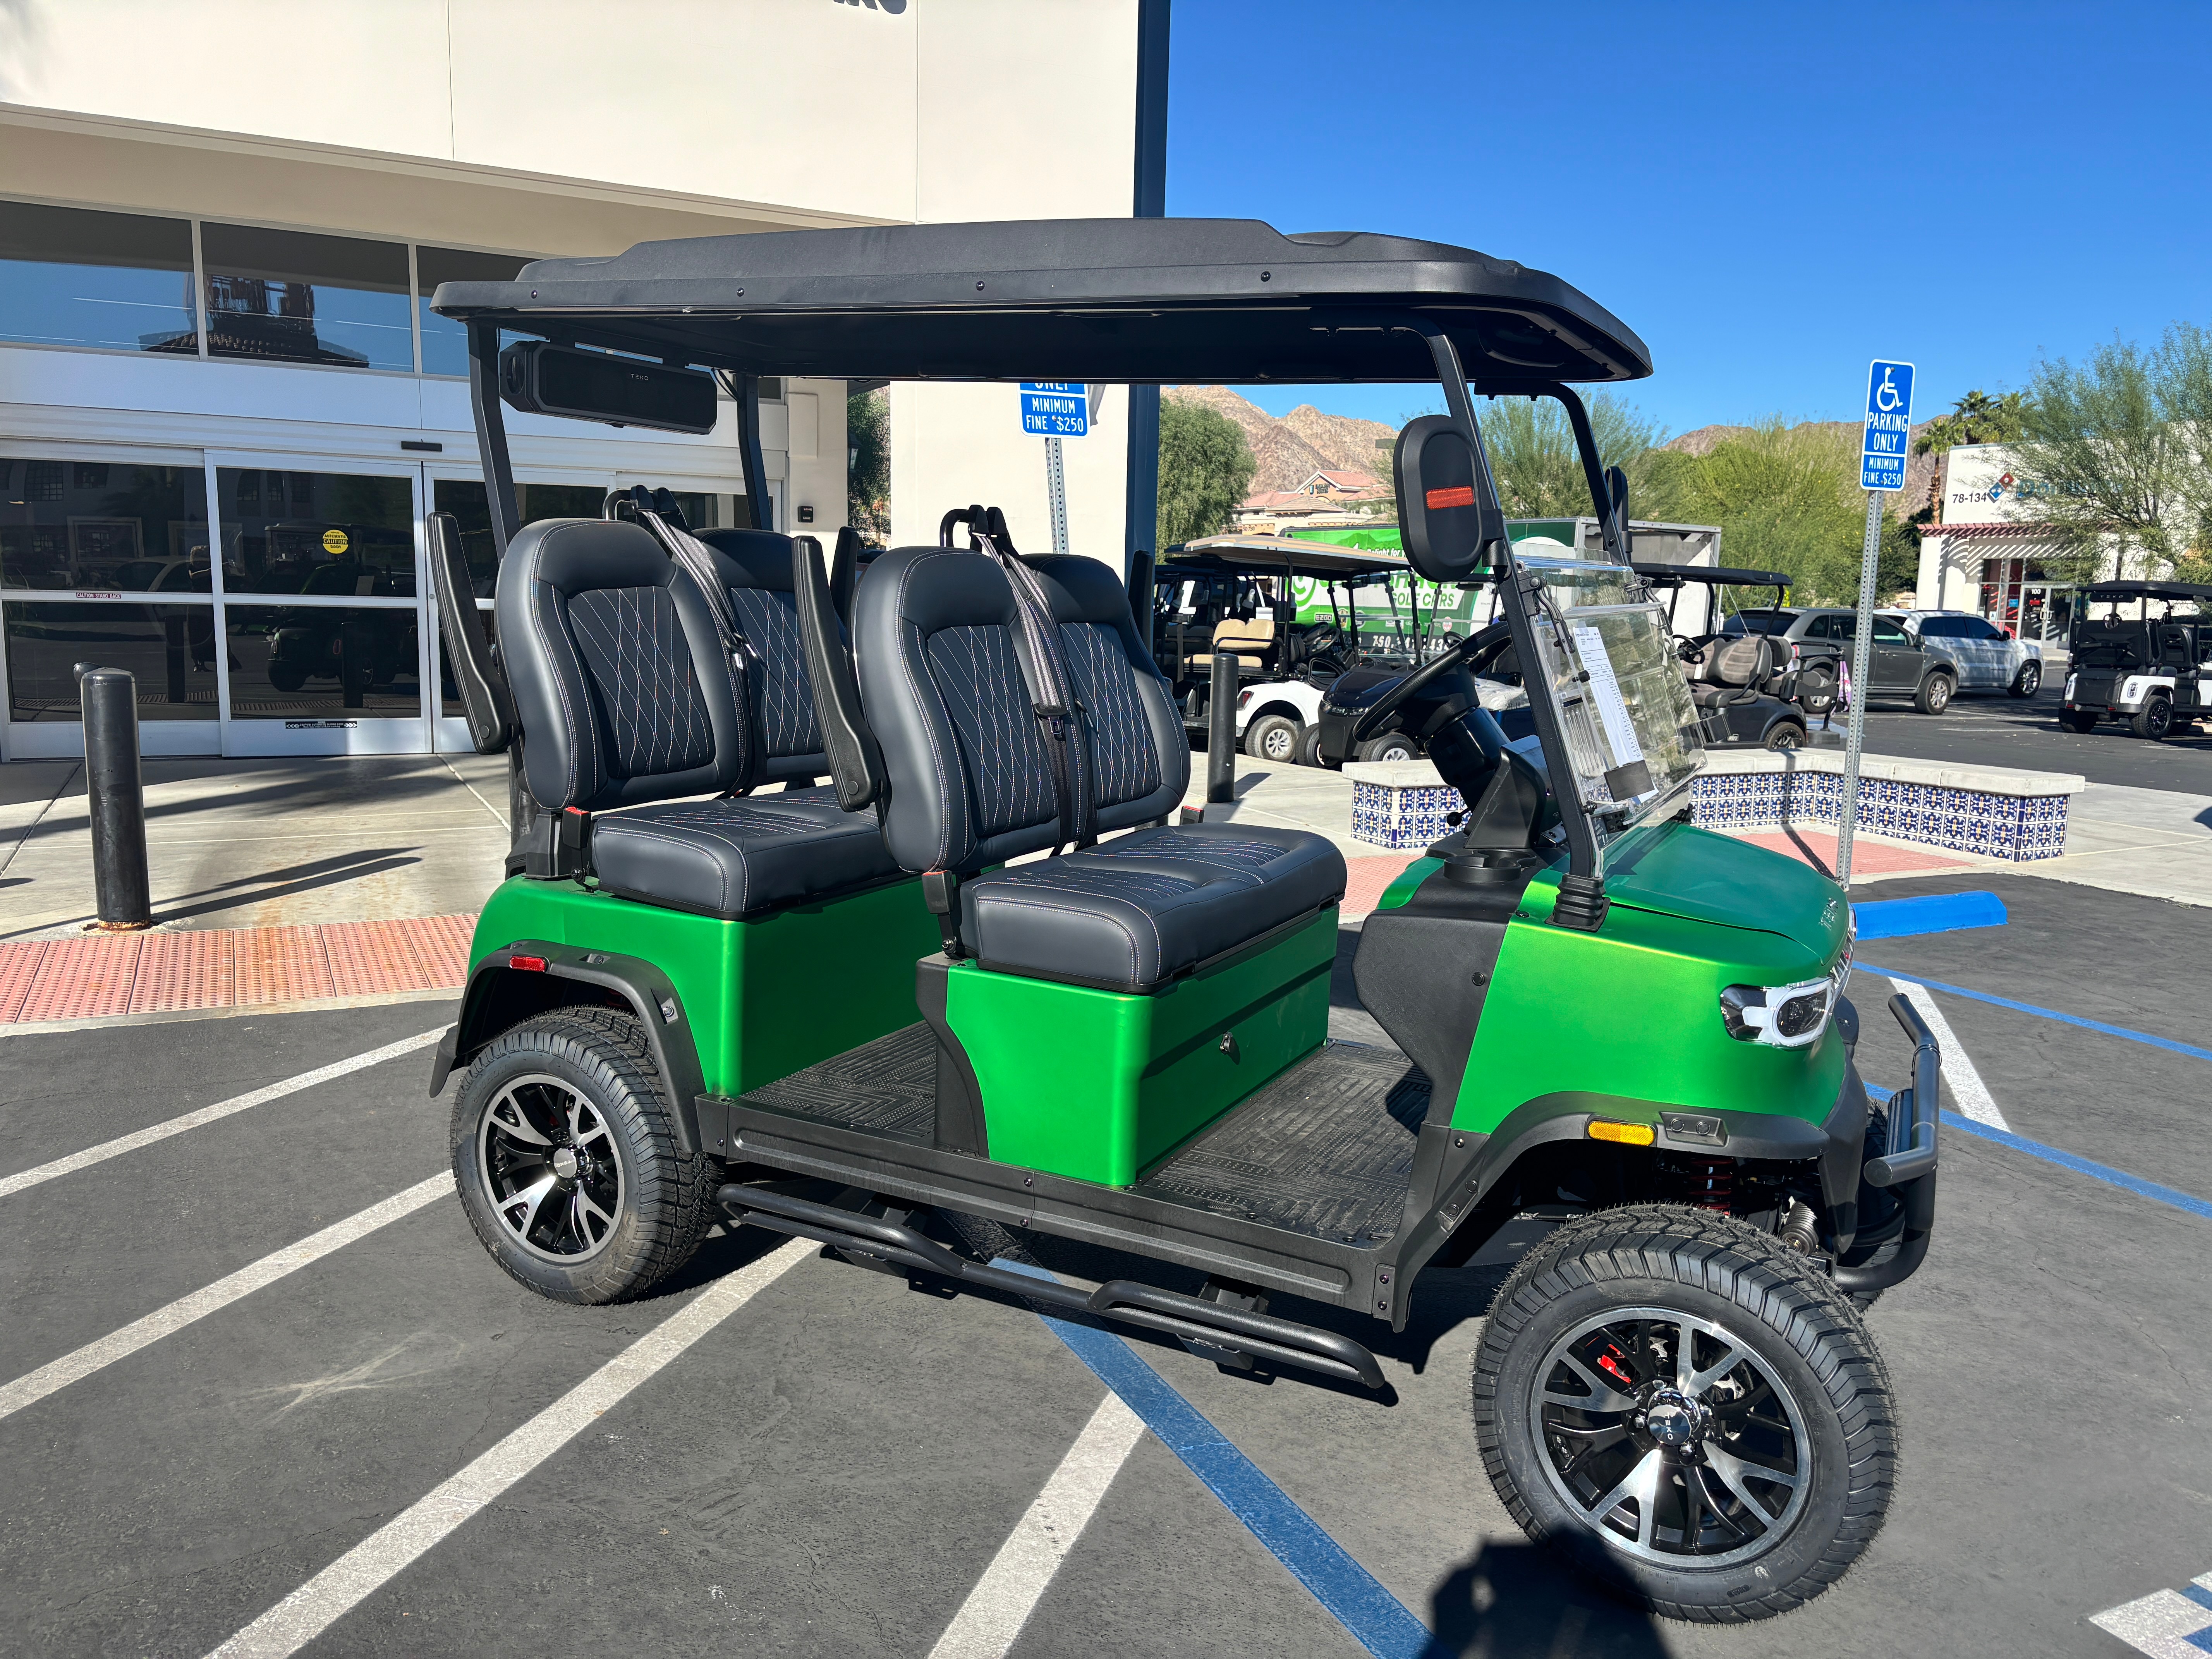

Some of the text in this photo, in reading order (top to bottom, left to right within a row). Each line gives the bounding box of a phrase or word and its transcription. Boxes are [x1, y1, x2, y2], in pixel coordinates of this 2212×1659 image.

[1032, 397, 1075, 414] MINIMUM
[1026, 415, 1084, 433] FINE $250
[1867, 412, 1908, 433] PARKING
[1874, 432, 1898, 452] ONLY
[1869, 457, 1899, 471] MINIMUM
[1864, 471, 1901, 486] FINE $250
[1953, 492, 1987, 503] 78-134
[1391, 548, 1401, 556] for
[1422, 593, 1455, 607] CRS
[1664, 1412, 1673, 1440] TEKO
